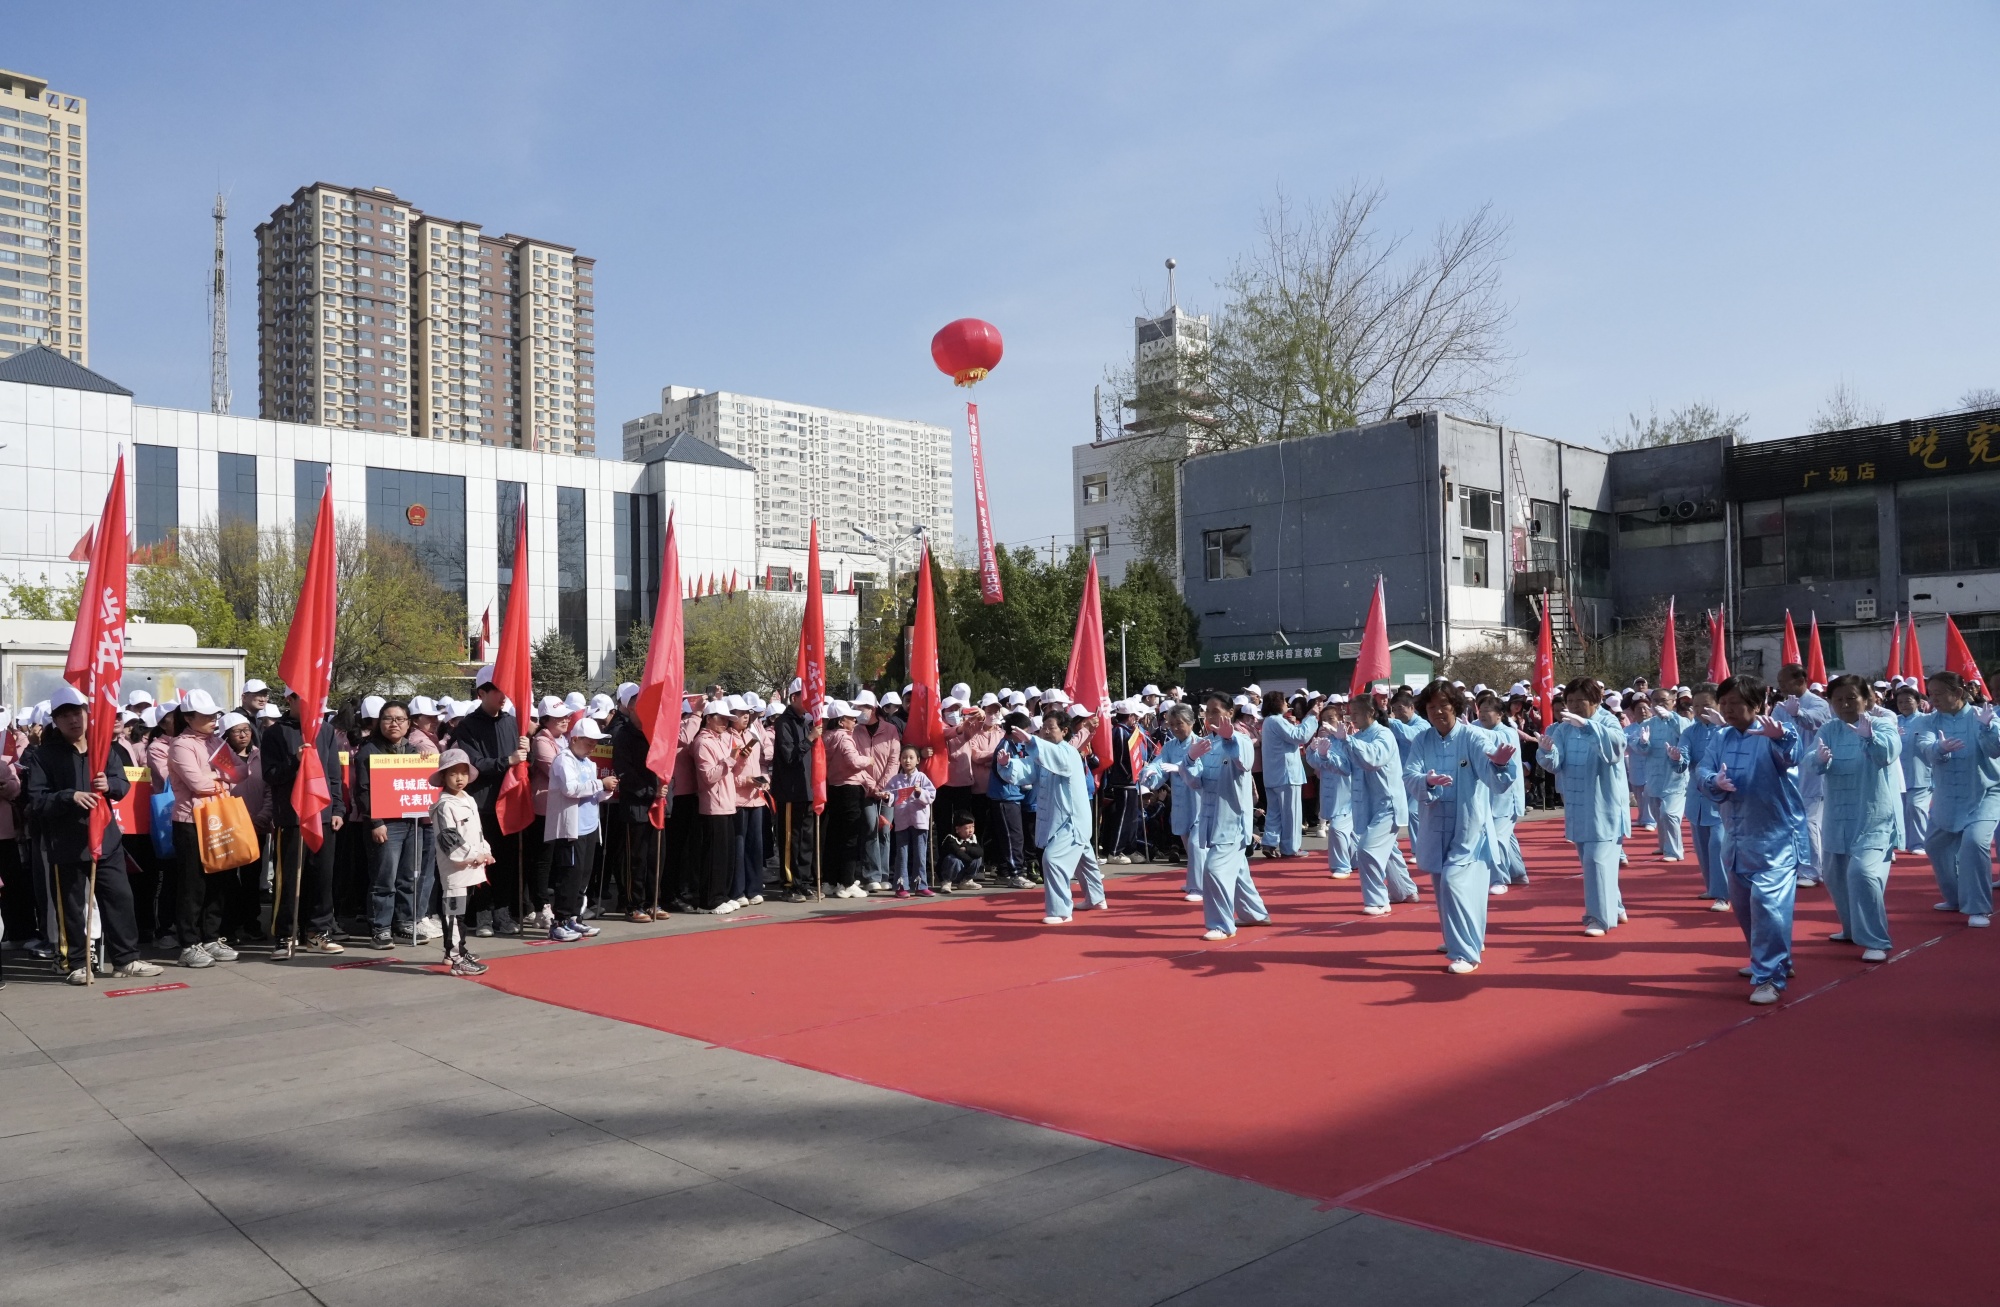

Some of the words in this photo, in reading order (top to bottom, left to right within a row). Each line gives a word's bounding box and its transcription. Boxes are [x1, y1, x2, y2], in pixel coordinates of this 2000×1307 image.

[1802, 461, 1876, 488] 广场店
[1213, 646, 1323, 663] 古交市垃圾分类科普宣教室
[399, 793, 433, 806] 代表队
